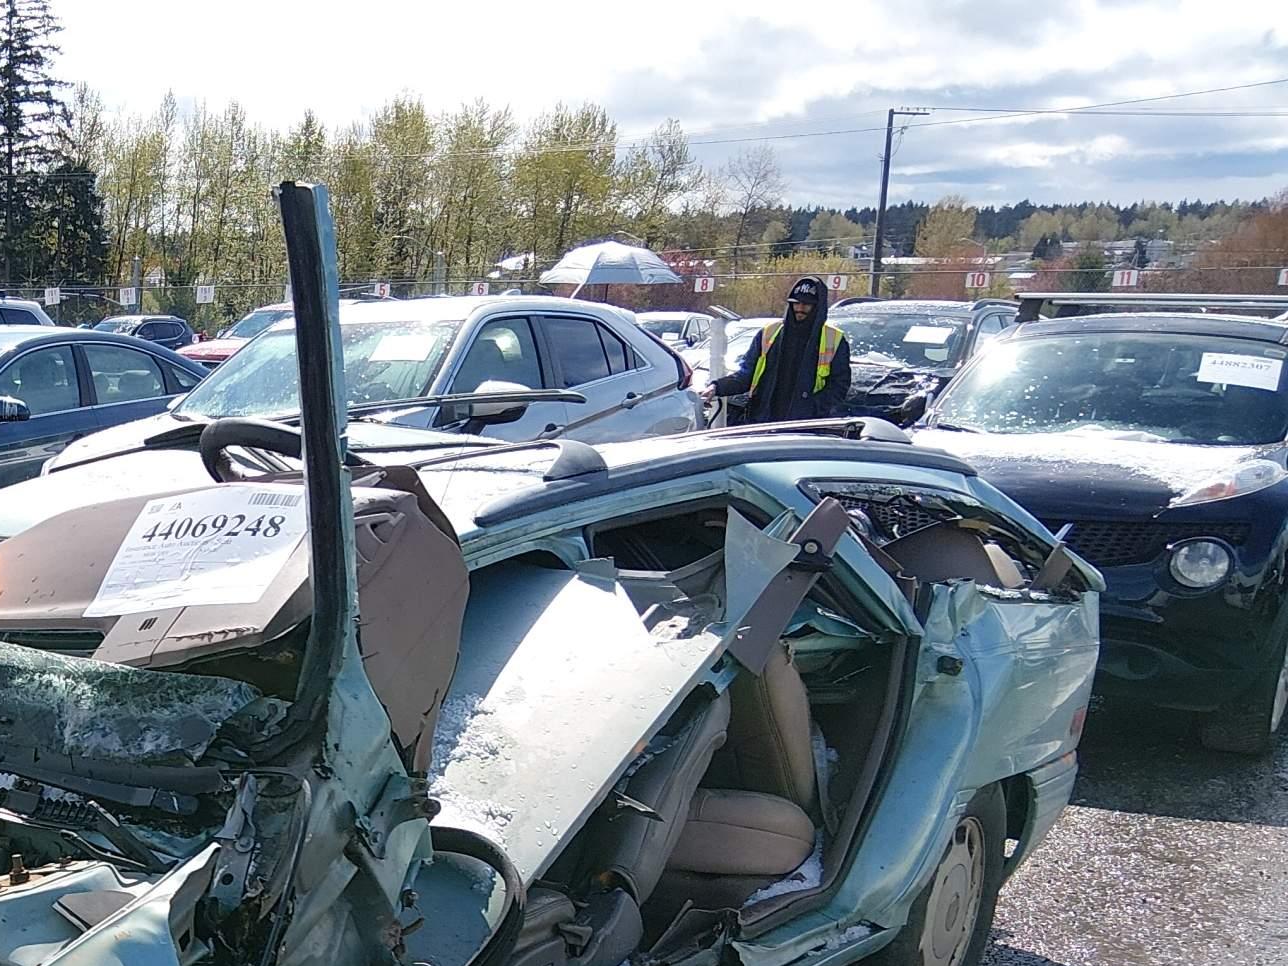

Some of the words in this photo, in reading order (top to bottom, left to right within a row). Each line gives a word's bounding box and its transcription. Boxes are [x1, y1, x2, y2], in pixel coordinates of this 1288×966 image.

[700, 278, 709, 291] 8
[832, 276, 841, 289] 9
[970, 273, 986, 287] 10
[1119, 271, 1131, 285] 11
[378, 284, 386, 297] 5
[477, 283, 485, 296] 6
[142, 513, 286, 543] 44069248
